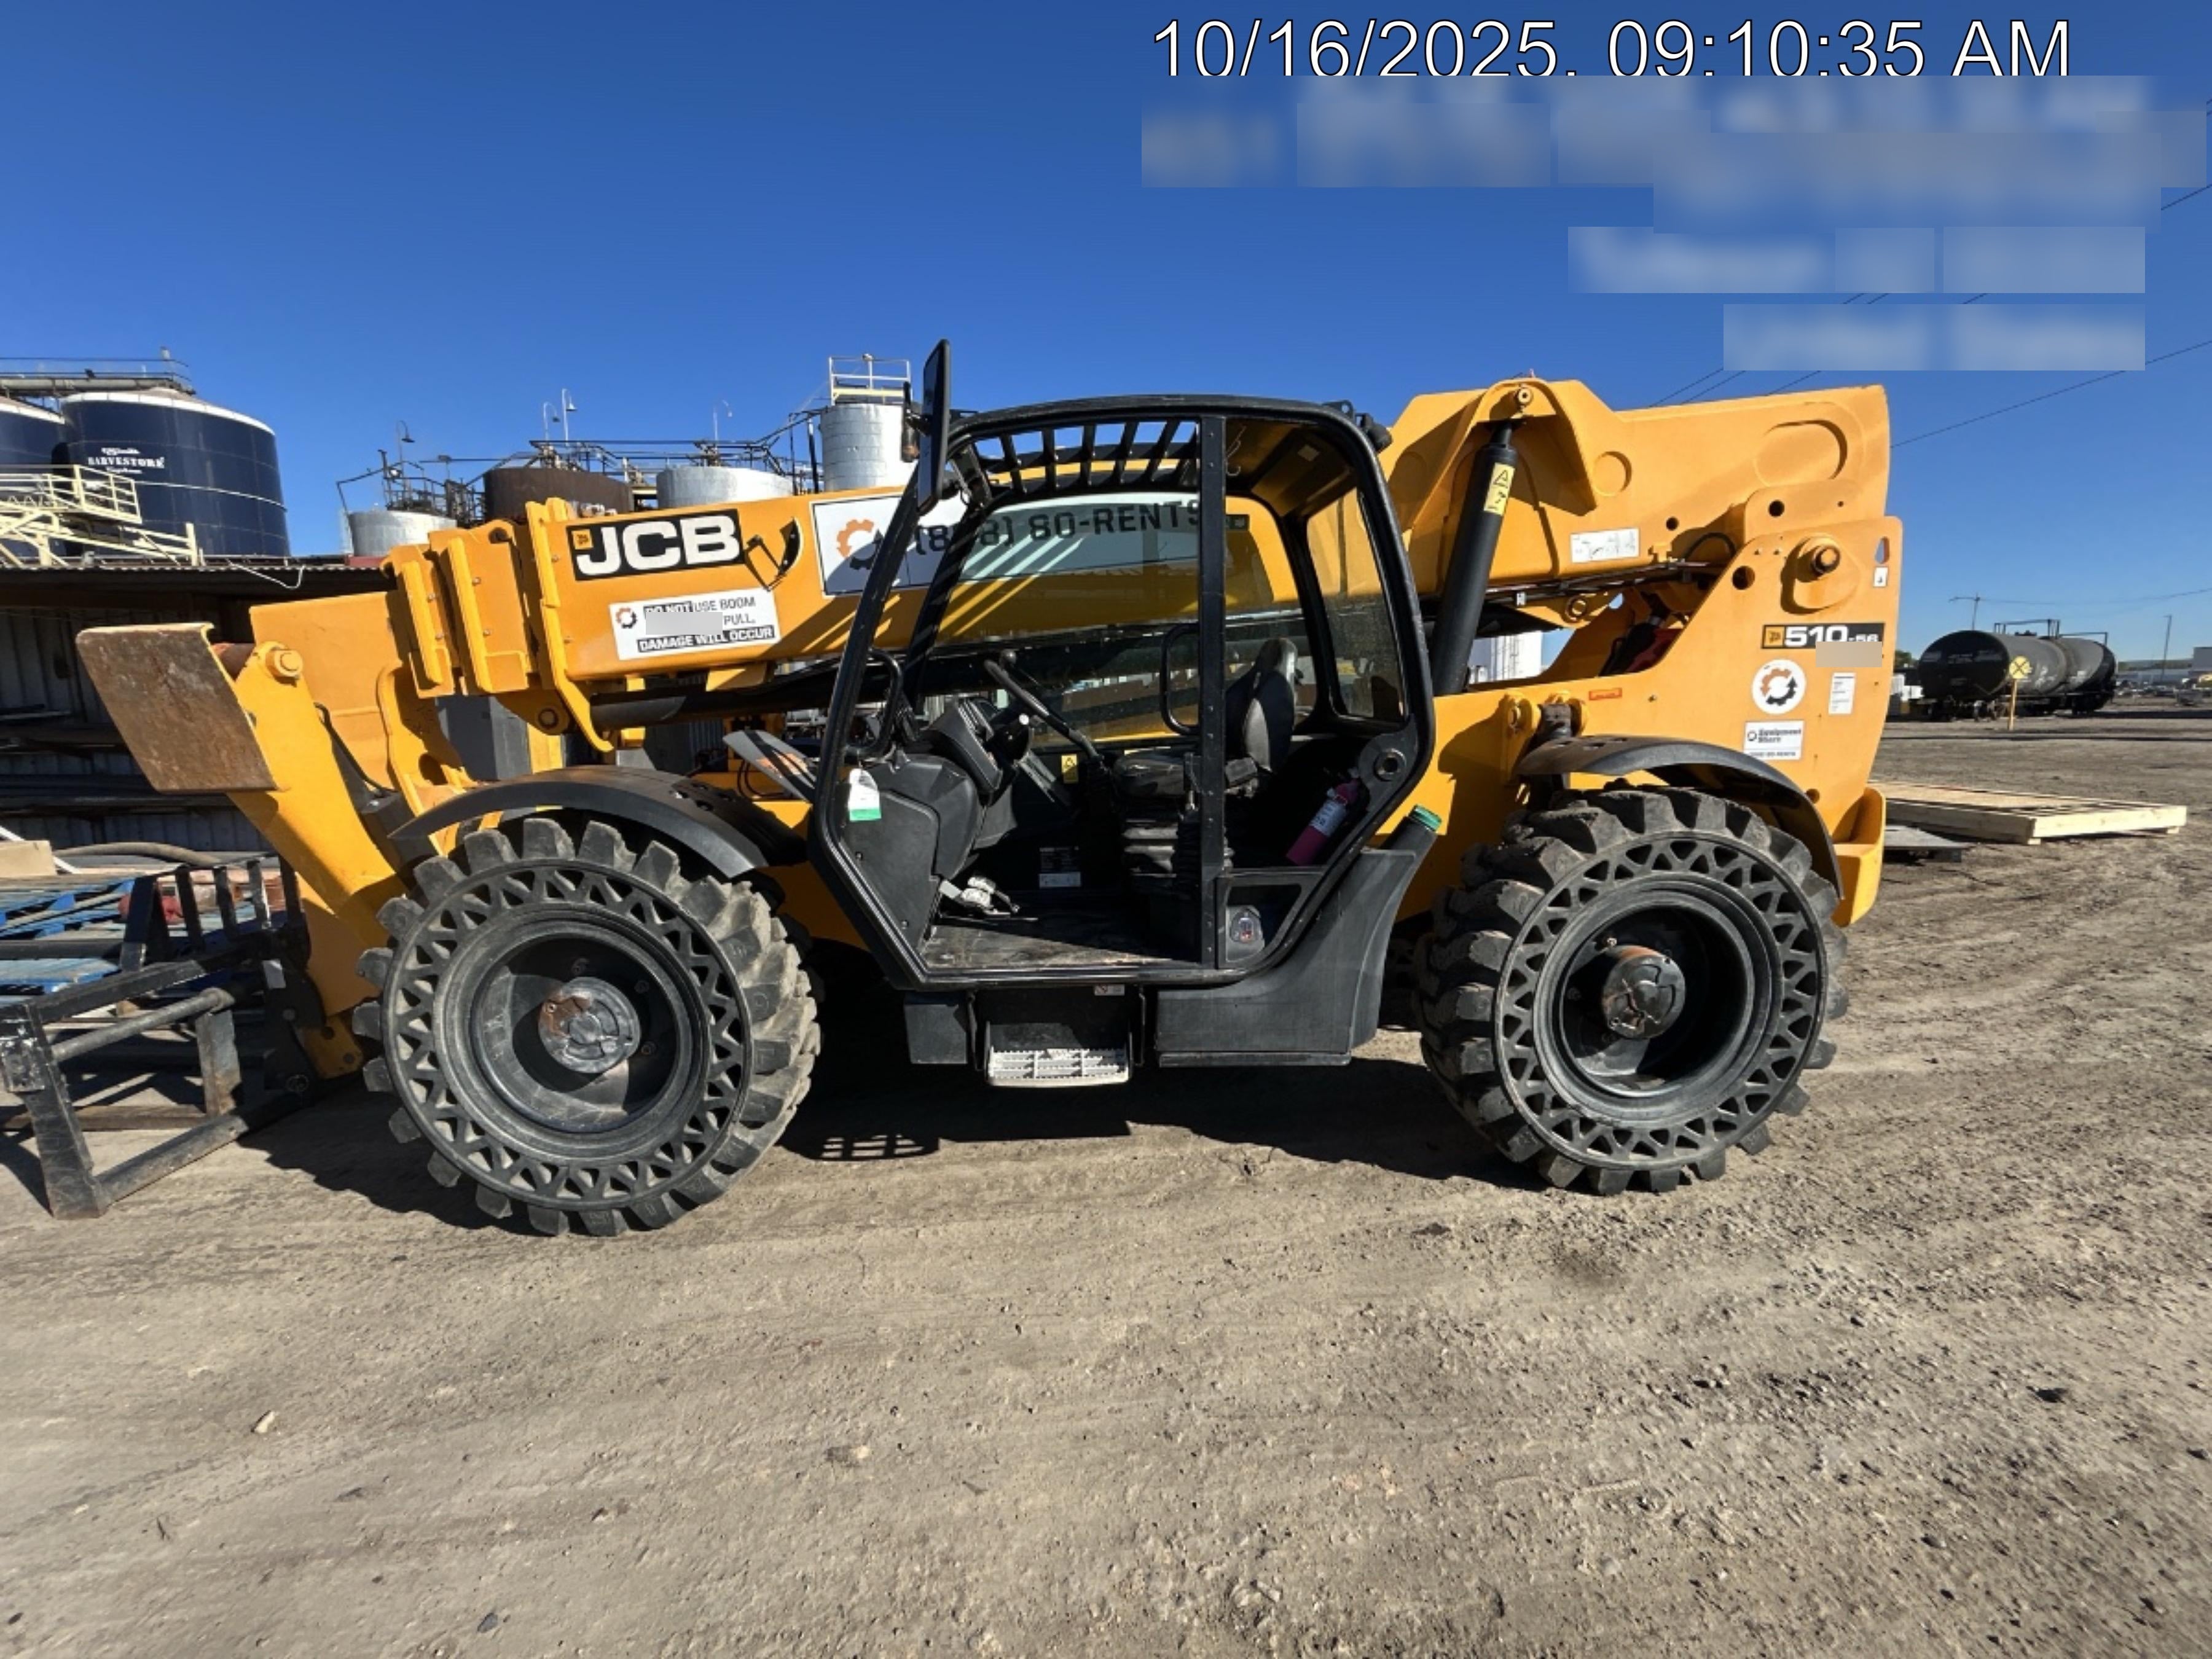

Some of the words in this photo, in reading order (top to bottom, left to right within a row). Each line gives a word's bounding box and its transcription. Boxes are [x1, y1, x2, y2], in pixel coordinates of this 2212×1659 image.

[576, 515, 740, 576] JCB
[914, 515, 1014, 555] (88)
[694, 600, 717, 612] USE
[719, 596, 756, 610] BOOM
[639, 635, 694, 651] DAMAGE
[695, 633, 728, 645] WILL
[729, 627, 773, 641] OCCUR
